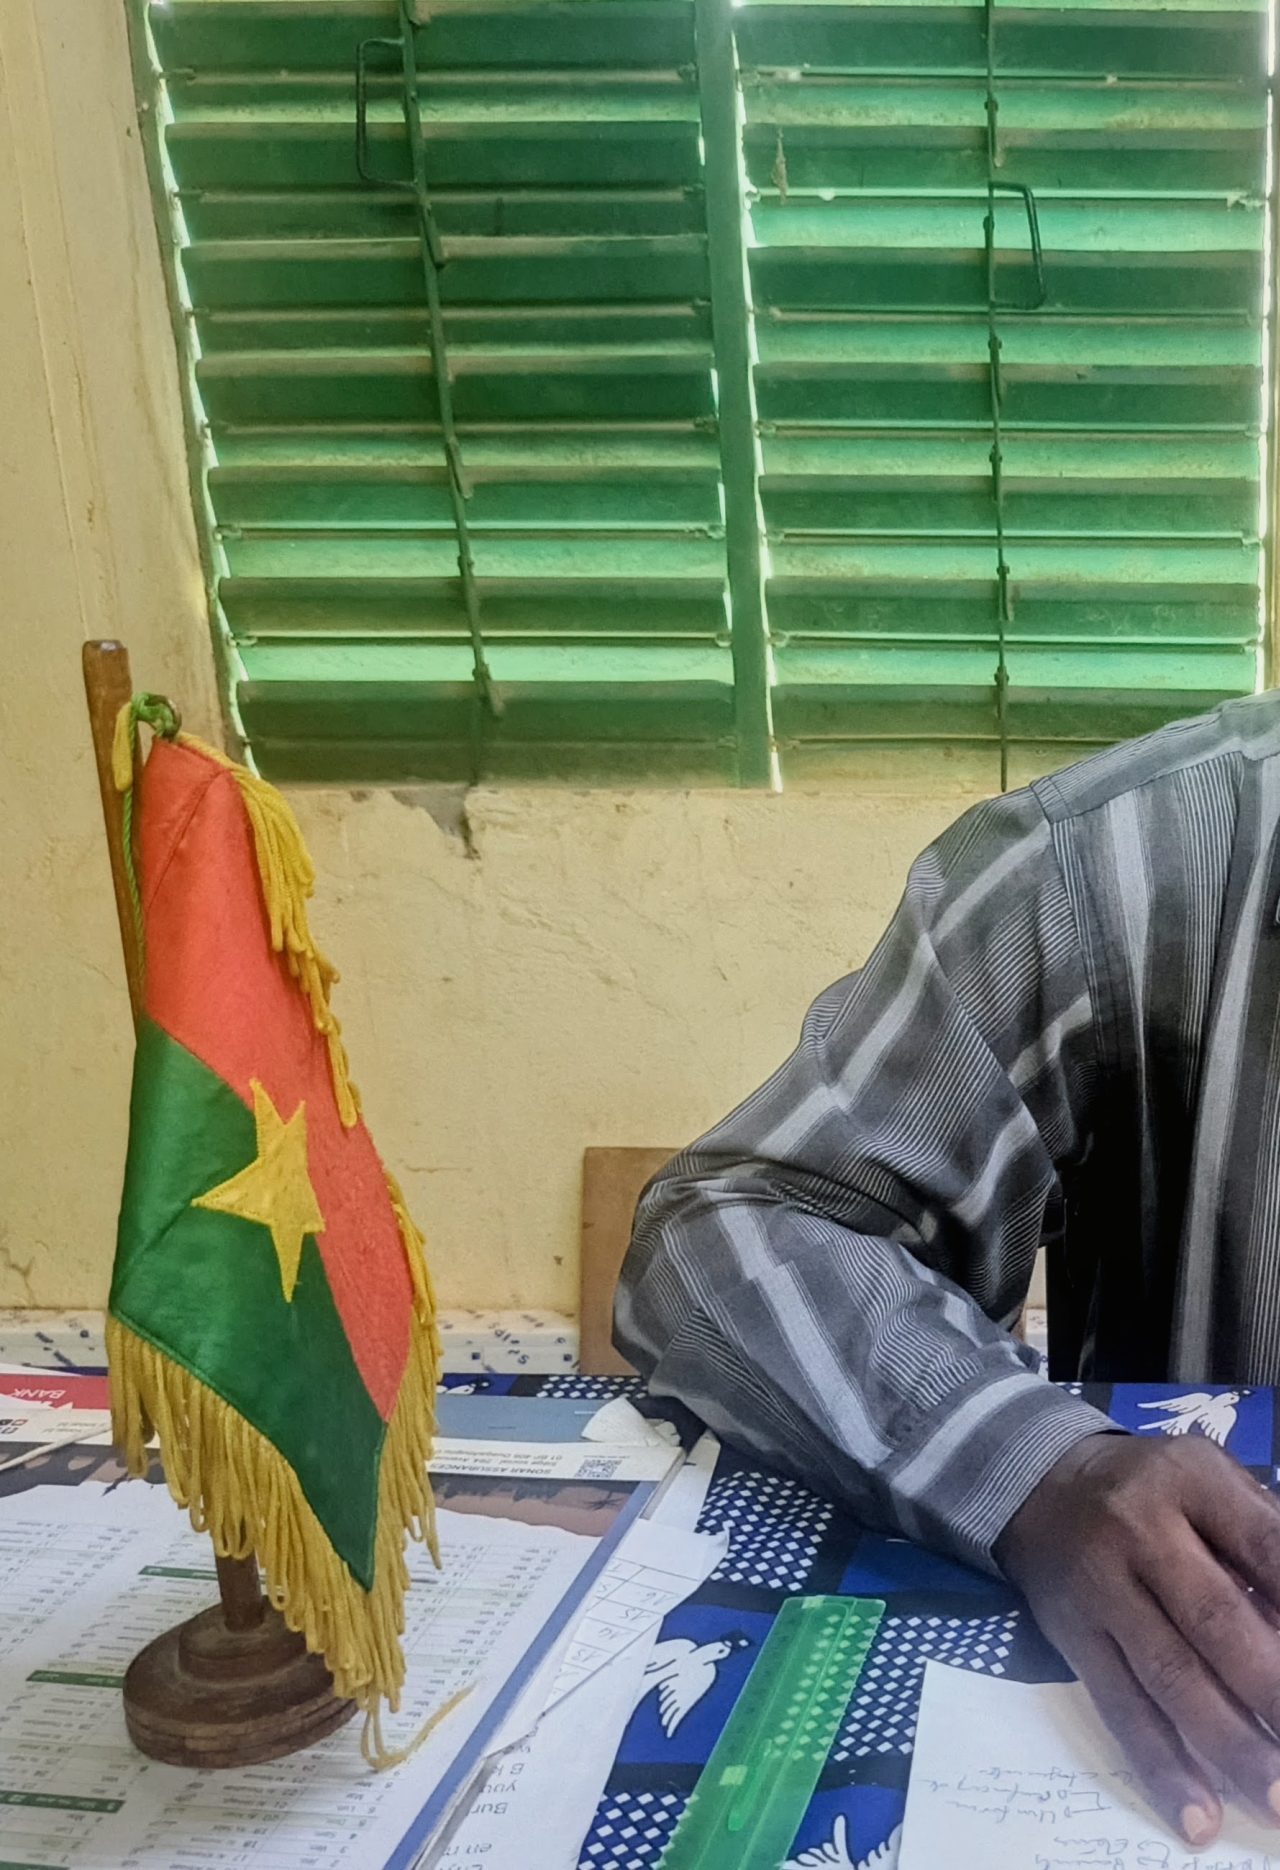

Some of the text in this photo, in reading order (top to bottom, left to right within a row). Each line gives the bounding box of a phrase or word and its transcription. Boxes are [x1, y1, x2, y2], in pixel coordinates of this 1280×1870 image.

[12, 1388, 67, 1400] BANK
[429, 1463, 553, 1475] SONAR ASSURANCES
